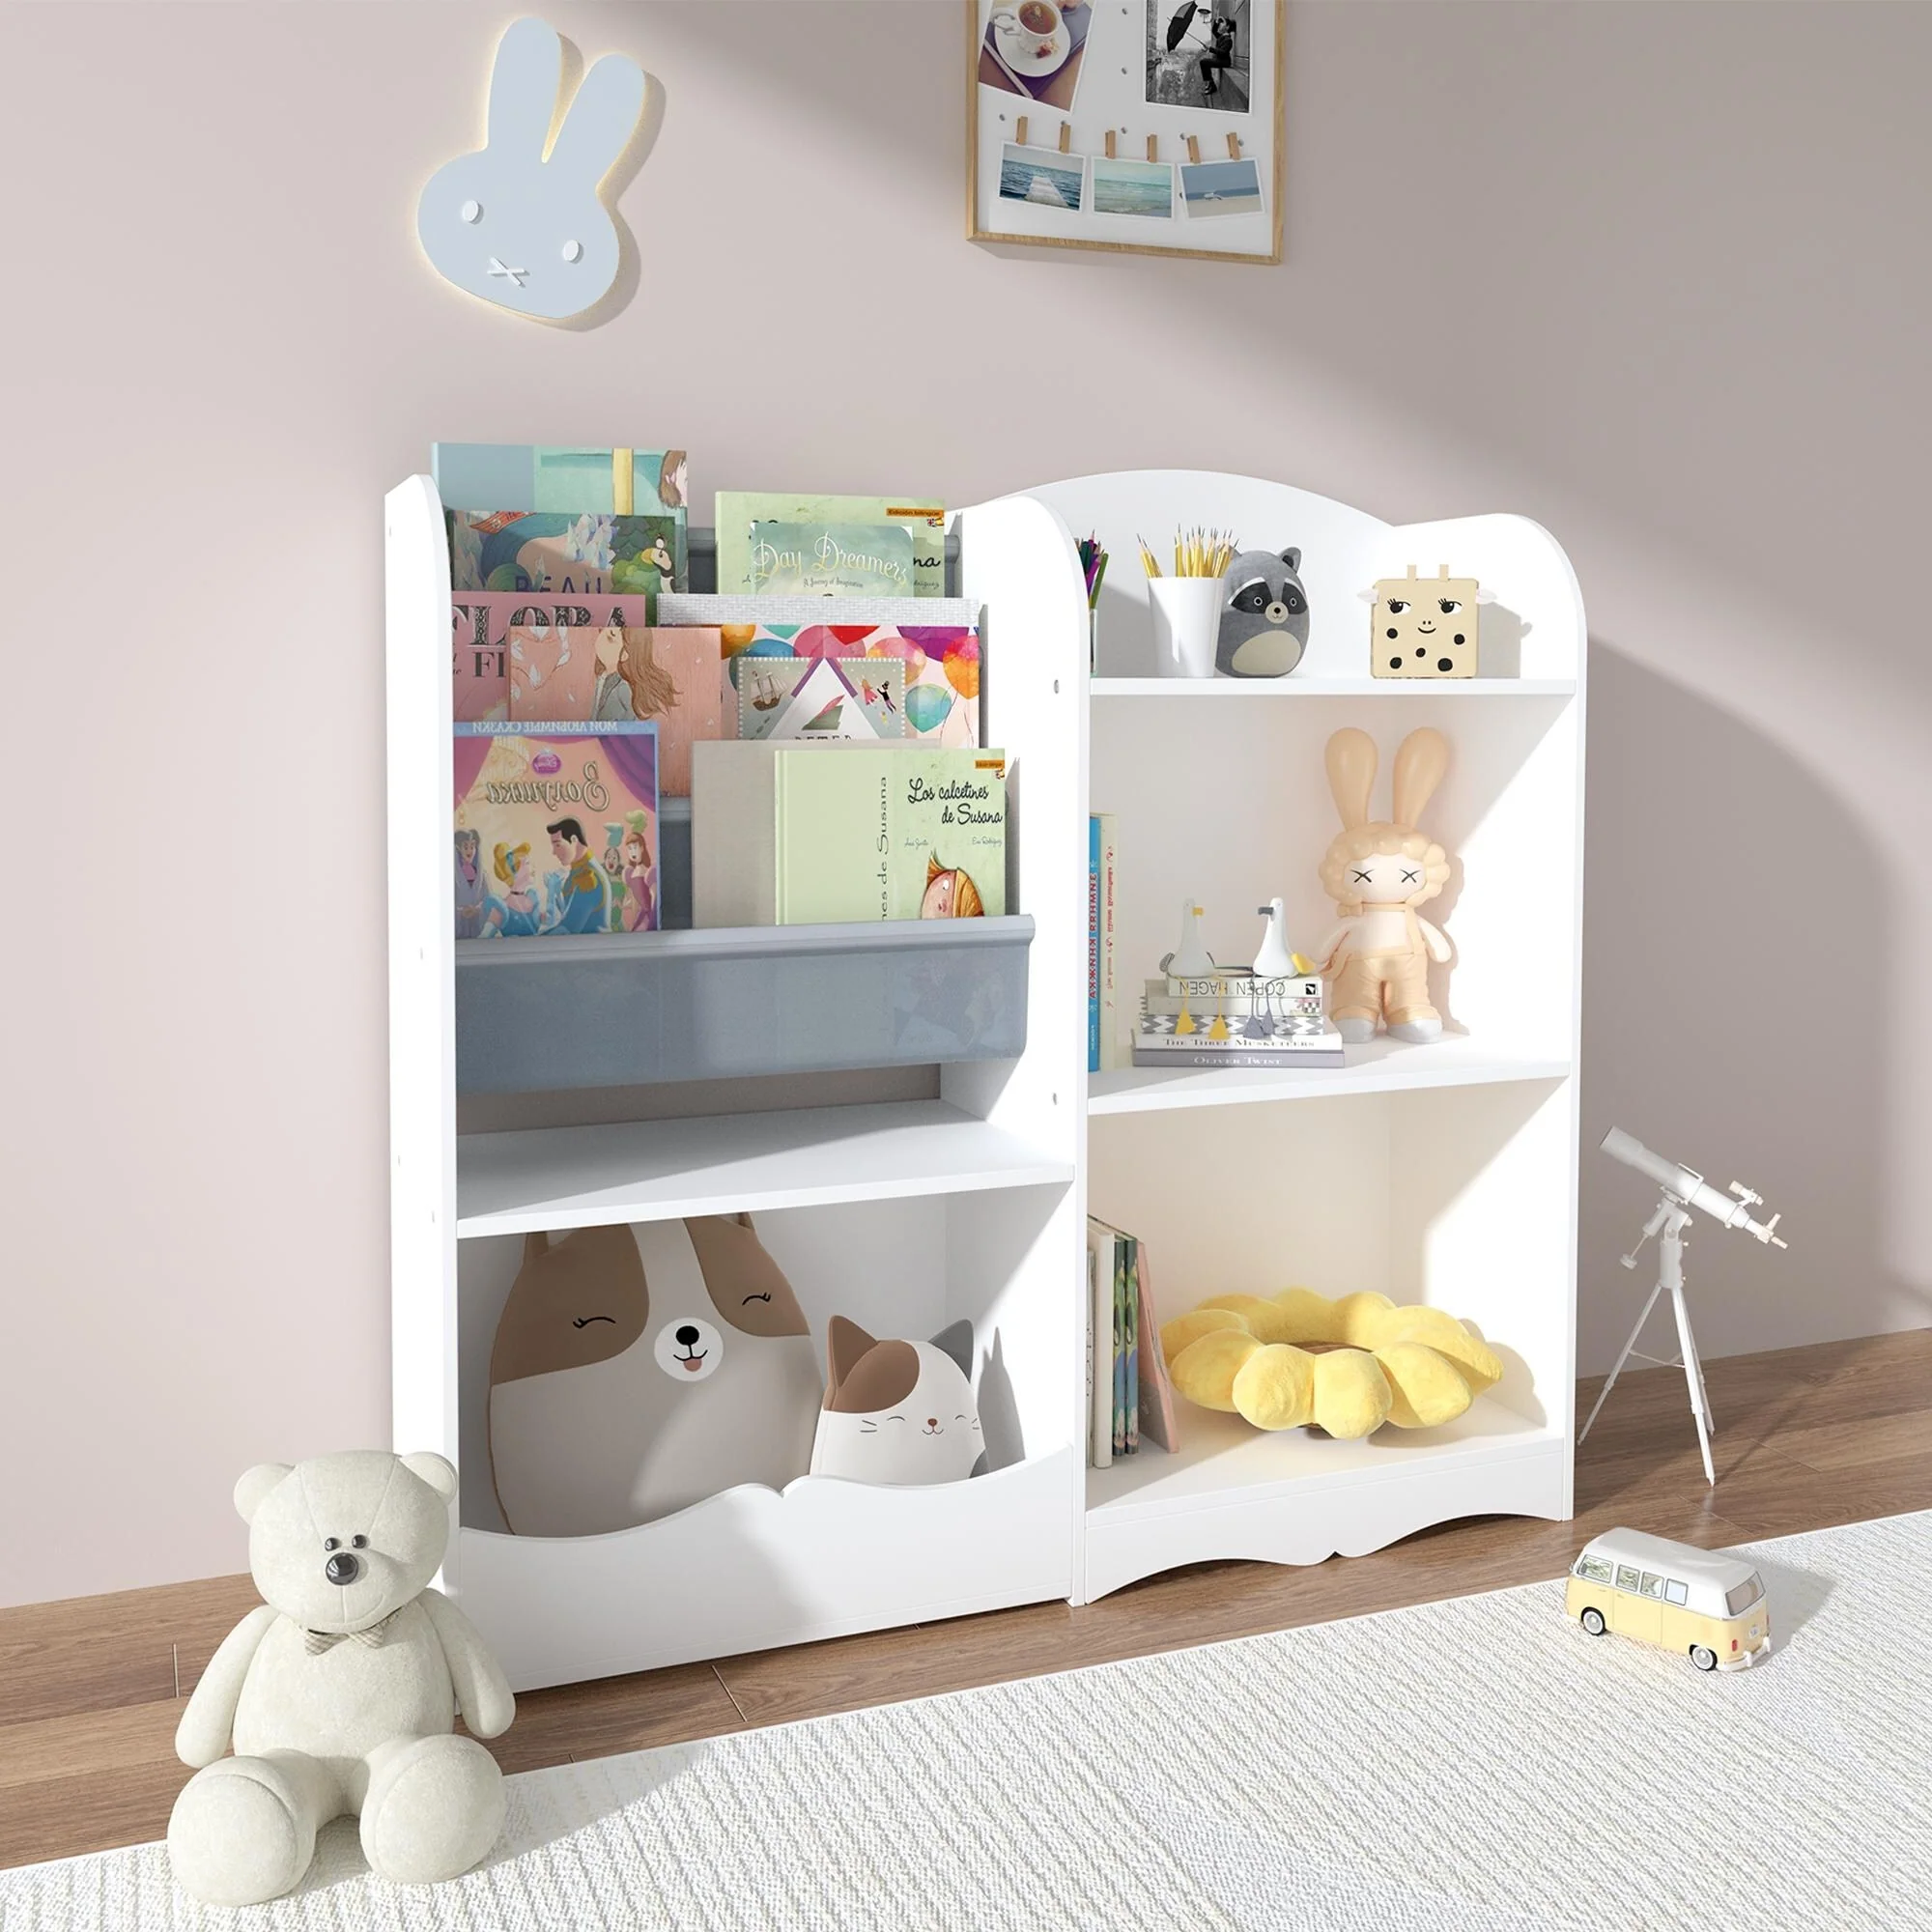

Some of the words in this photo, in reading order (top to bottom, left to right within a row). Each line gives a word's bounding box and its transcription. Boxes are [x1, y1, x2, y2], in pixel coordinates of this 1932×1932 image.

[753, 538, 802, 580] Day
[811, 531, 908, 586] Dreamers
[908, 778, 935, 804] Los
[939, 780, 989, 800] calcetines
[876, 777, 889, 855] Susana
[942, 805, 954, 824] de
[957, 803, 1003, 825] Susana
